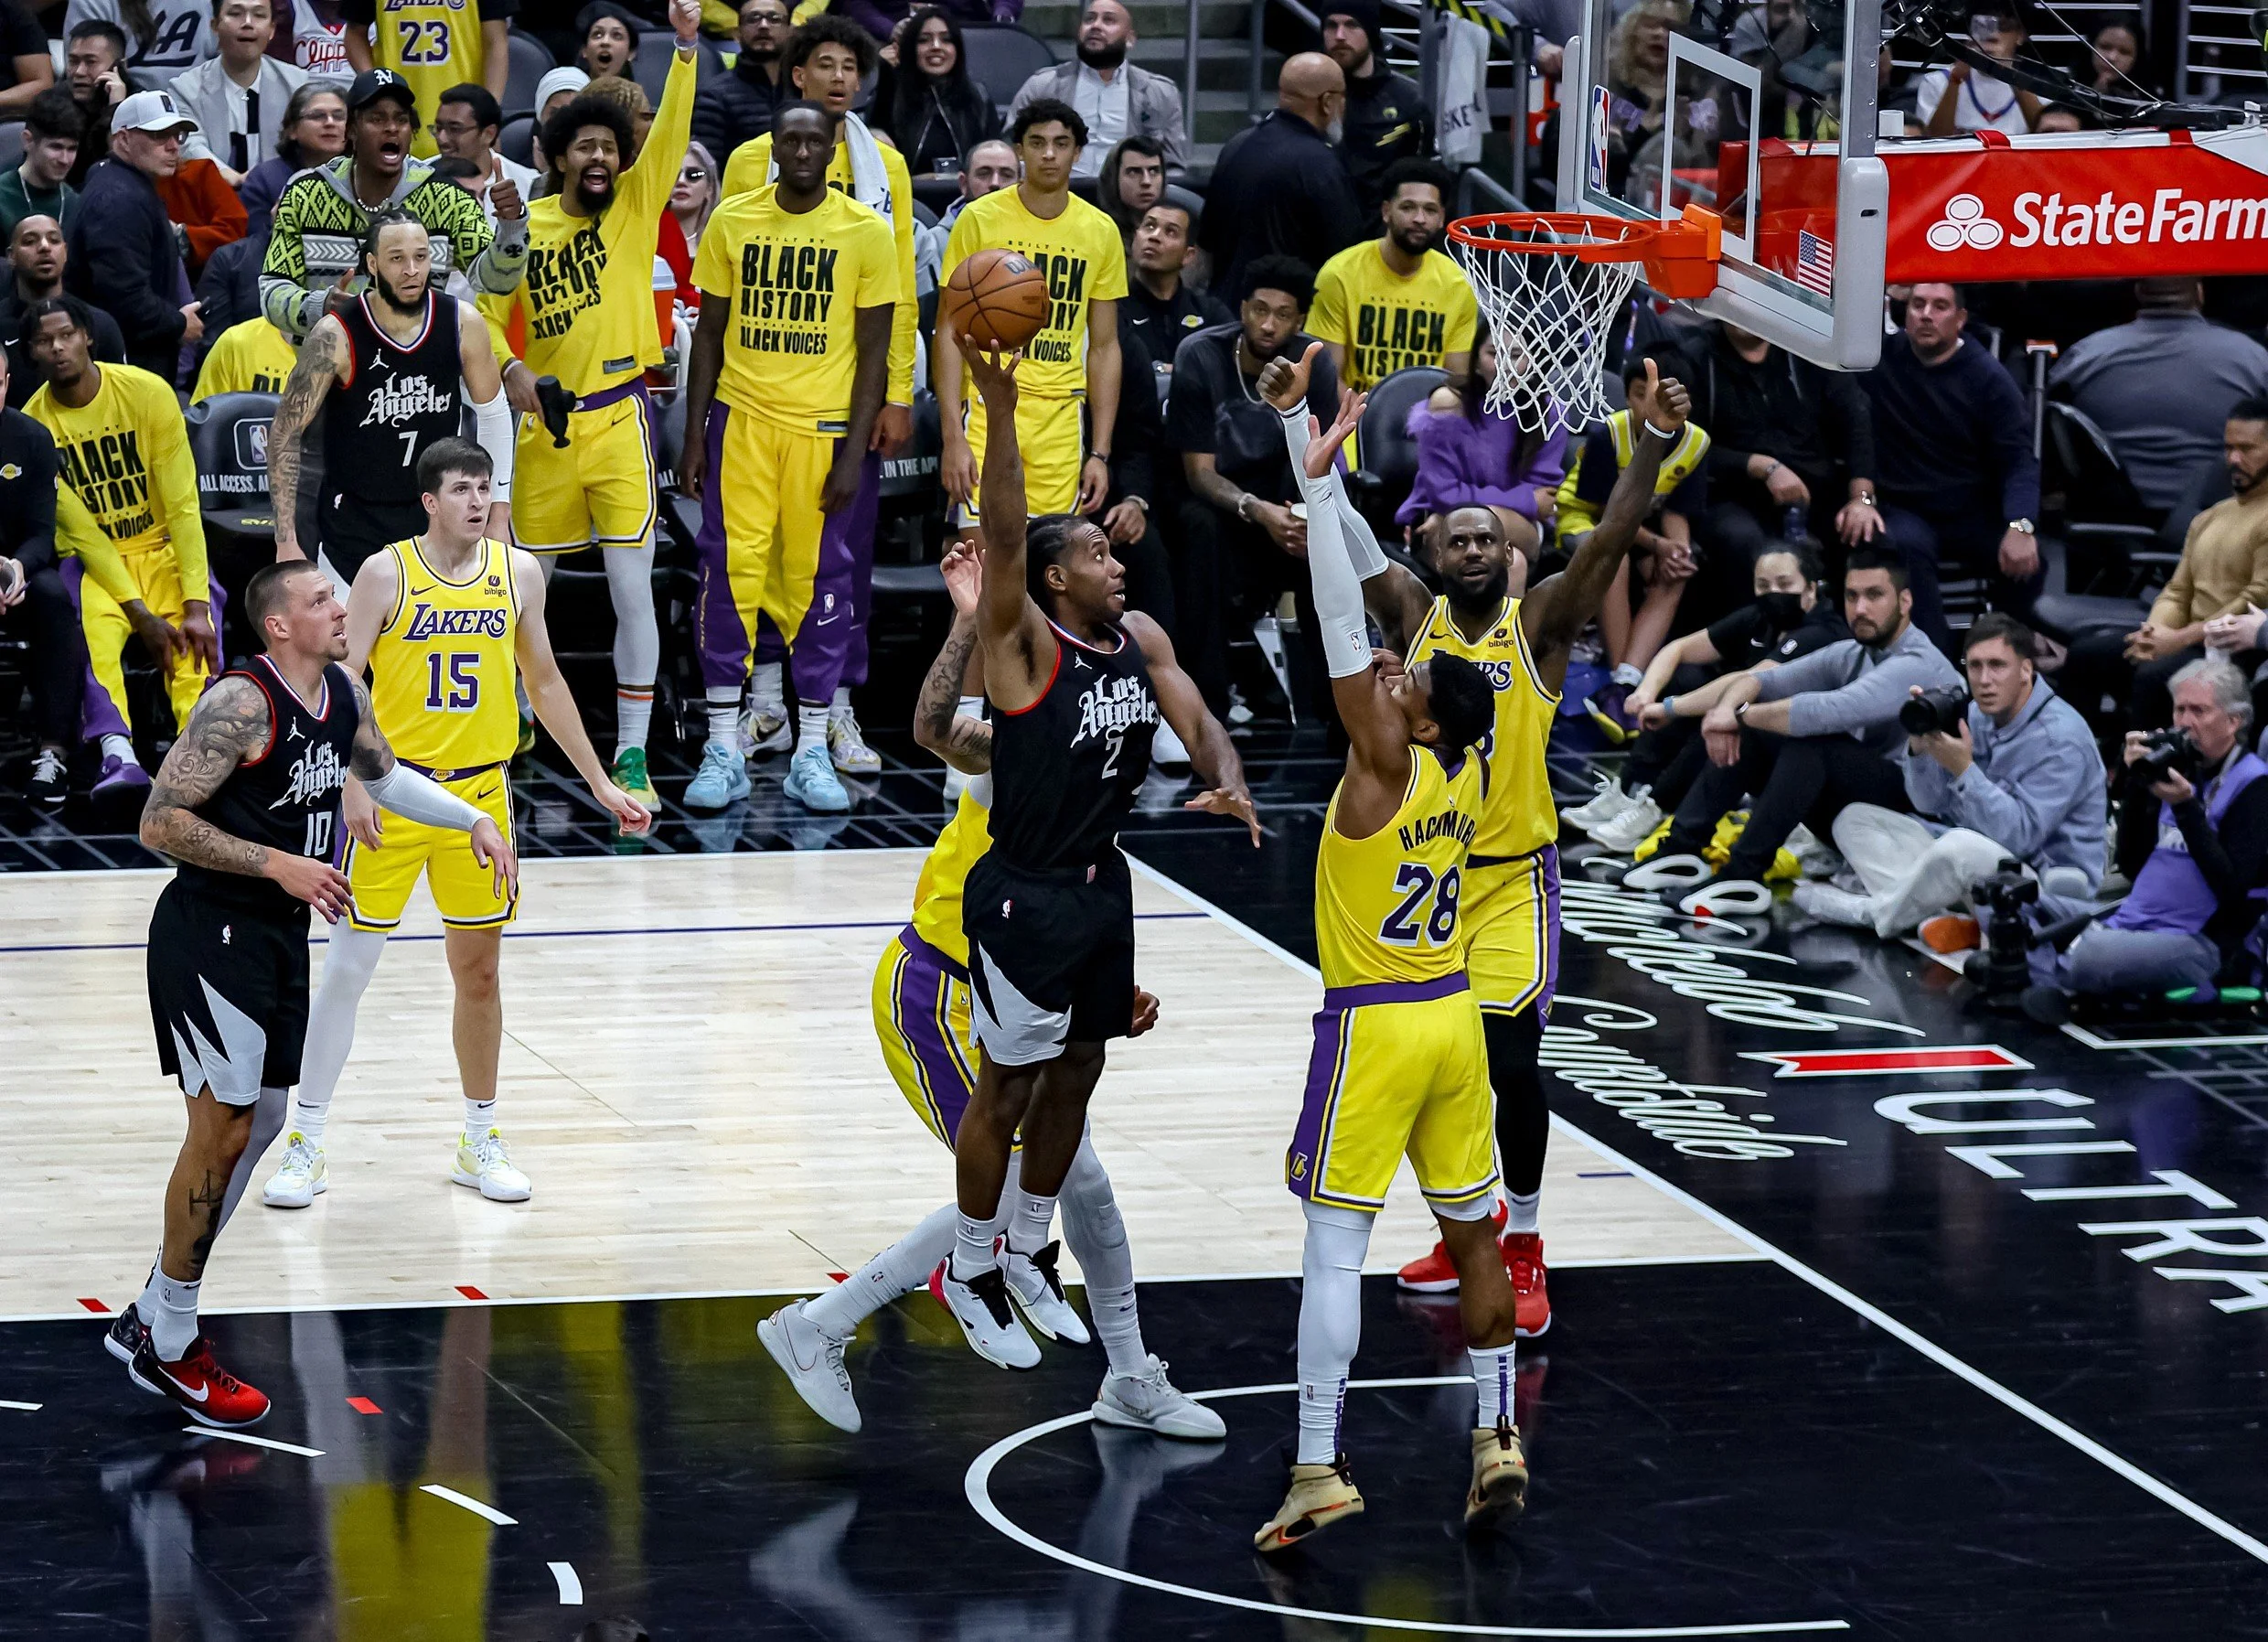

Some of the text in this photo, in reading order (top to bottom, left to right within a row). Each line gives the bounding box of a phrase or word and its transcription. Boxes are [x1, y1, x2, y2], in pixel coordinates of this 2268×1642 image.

[400, 20, 451, 66] 23
[742, 243, 839, 293] BLACK
[741, 286, 833, 323] HISTORY
[741, 326, 828, 355] BLACK VOICES
[1356, 304, 1447, 353] BLACK
[1034, 338, 1073, 363] VOICES
[384, 371, 428, 401] Los
[399, 431, 419, 467] 7
[200, 474, 219, 492] ALL
[219, 474, 257, 493] ACCESS.
[883, 460, 897, 478] IN
[897, 457, 919, 476] THE
[485, 587, 508, 597] bibigo
[402, 603, 508, 641] LAKERS
[1488, 639, 1514, 649] bibigo
[424, 651, 481, 713] 15
[1094, 673, 1141, 706] Los
[304, 739, 333, 771] Los
[1102, 735, 1124, 779] 2
[268, 752, 350, 810] Angele
[304, 810, 333, 857] 10
[1377, 861, 1461, 949] 28
